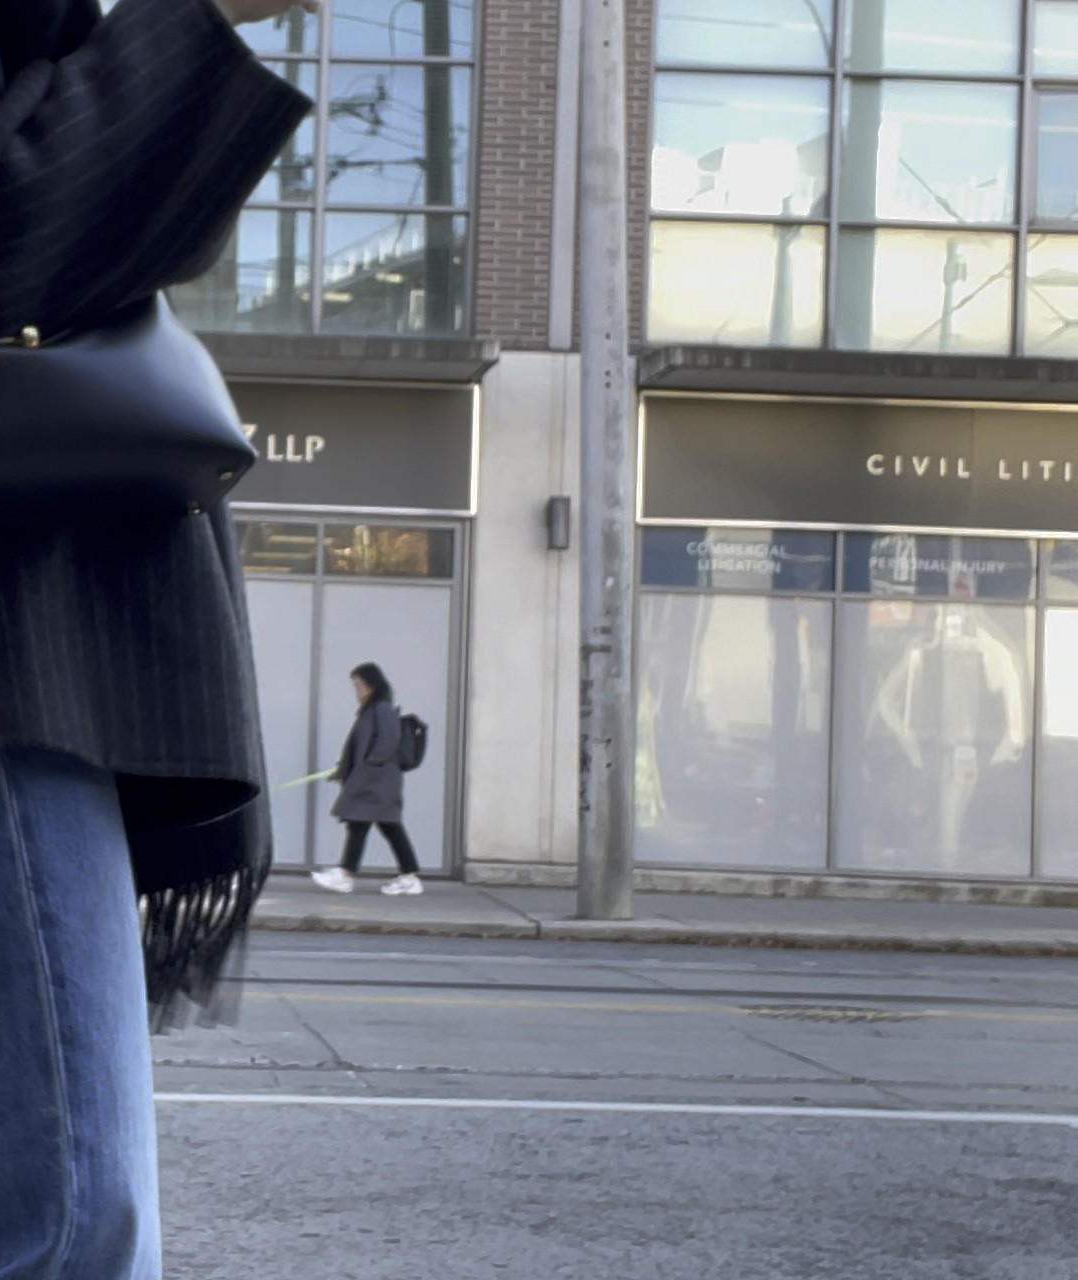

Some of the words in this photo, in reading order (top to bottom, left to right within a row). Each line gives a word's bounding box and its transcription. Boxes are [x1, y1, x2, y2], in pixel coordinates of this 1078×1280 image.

[266, 433, 326, 463] LLP
[866, 453, 971, 479] CIVIL
[998, 458, 1072, 483] LITI
